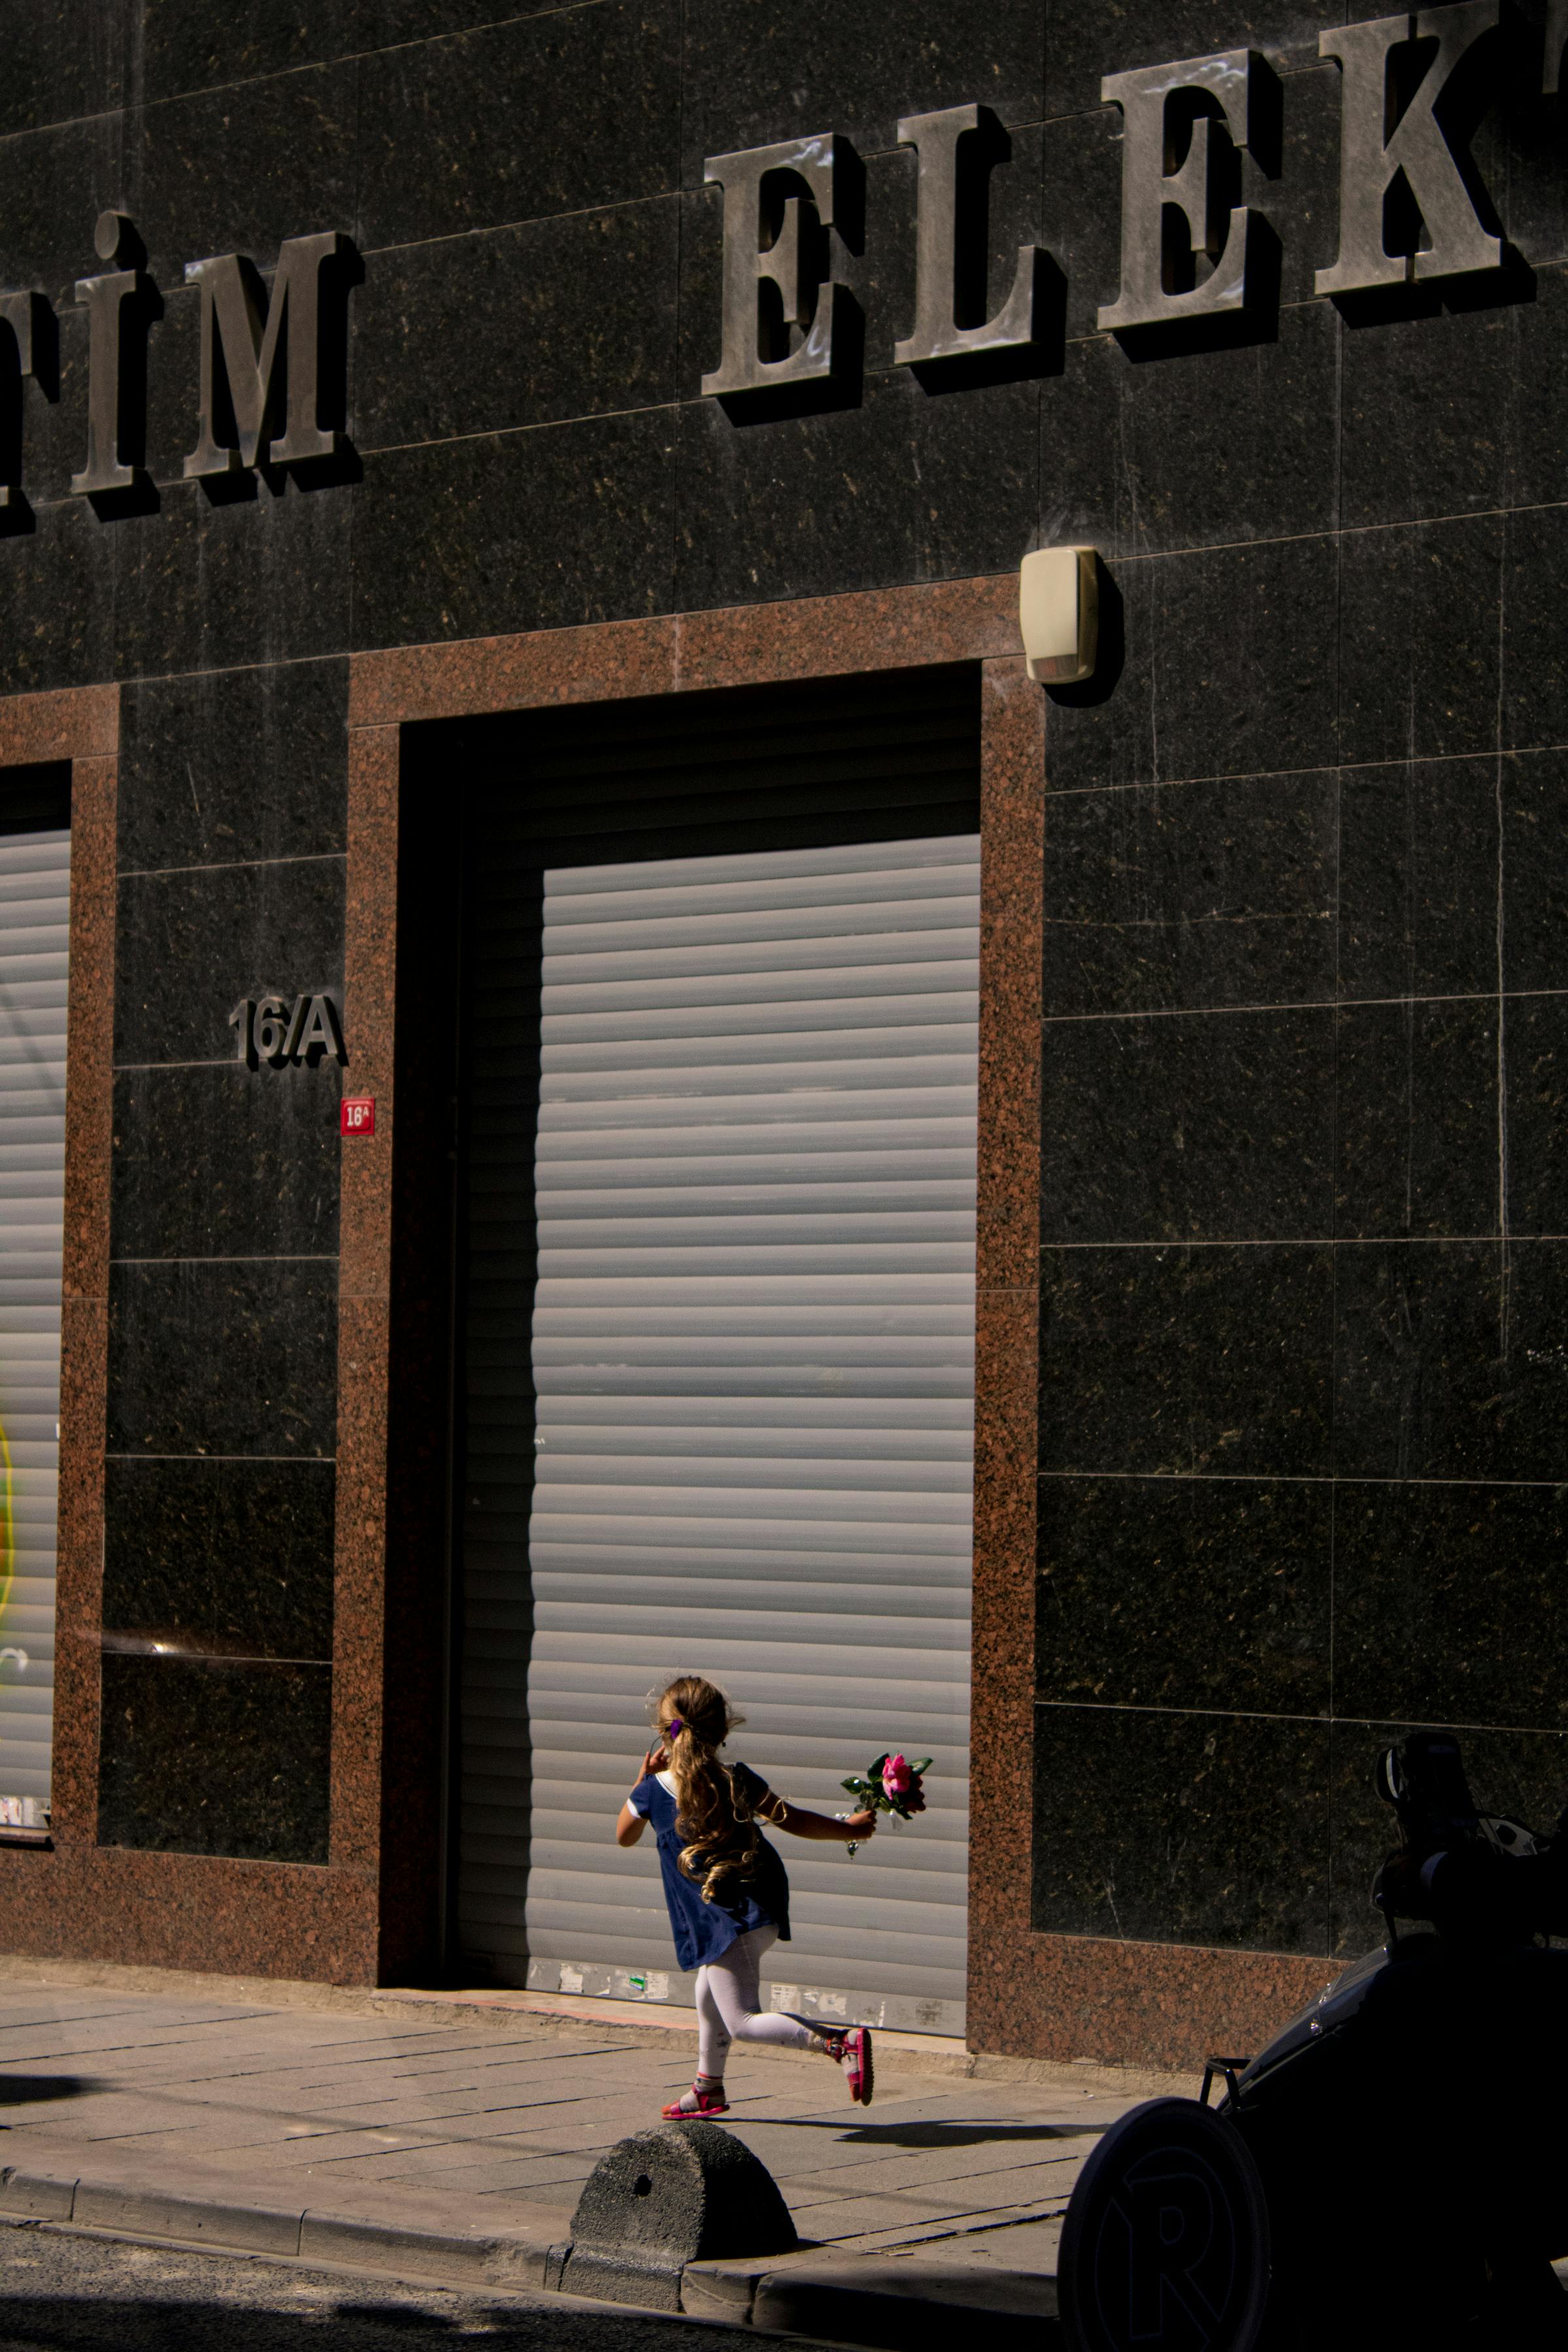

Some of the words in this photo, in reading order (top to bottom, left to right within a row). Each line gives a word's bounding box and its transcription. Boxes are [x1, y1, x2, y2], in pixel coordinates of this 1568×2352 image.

[701, 0, 1568, 396] ELEK
[229, 994, 338, 1060] 16/A
[347, 1105, 370, 1127] 16A
